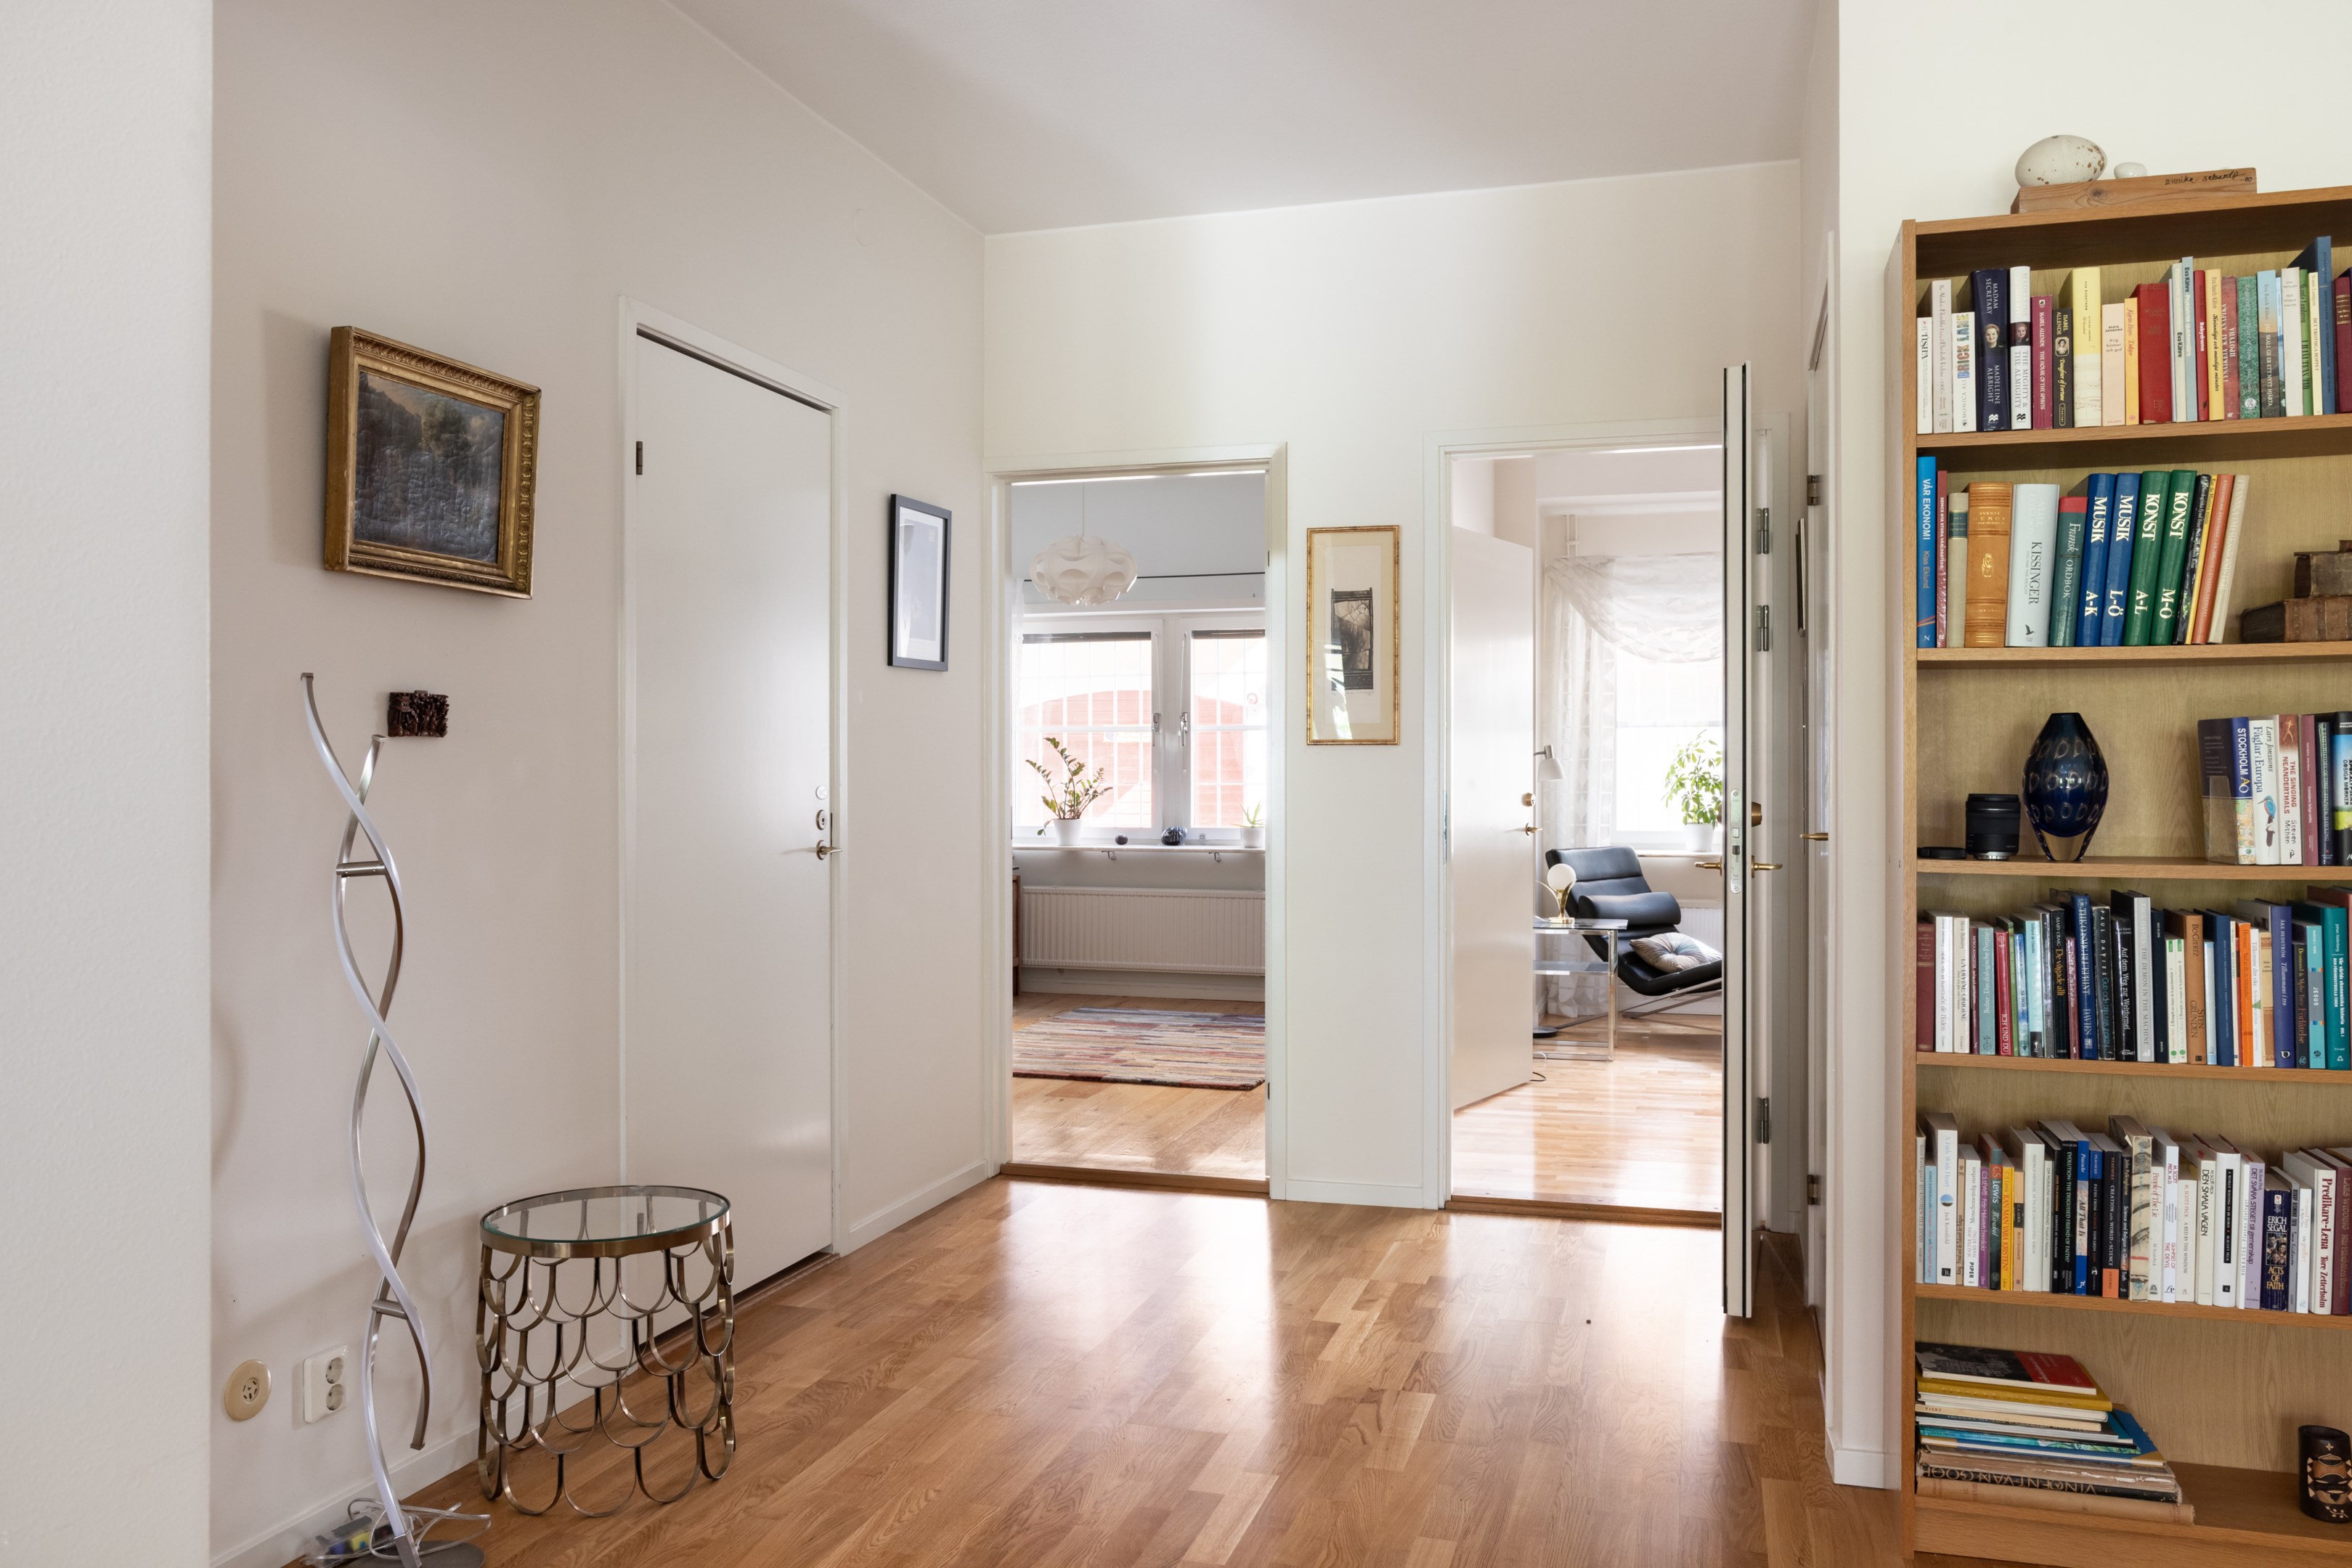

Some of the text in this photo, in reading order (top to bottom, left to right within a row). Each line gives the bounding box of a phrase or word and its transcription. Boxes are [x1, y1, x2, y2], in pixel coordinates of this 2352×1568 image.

[1956, 314, 1970, 379] BRICK LANE
[1922, 478, 1932, 495] VÅR
[2091, 496, 2108, 543] MUSIK
[2115, 494, 2134, 542] MUSIK
[2141, 494, 2161, 541] KONST
[2169, 491, 2189, 539] KONST
[2219, 479, 2246, 590] FRANSKA IMPRESSIONISTER
[2029, 541, 2043, 605] KISSINGER
[2062, 523, 2081, 598] Fransk ORDBOK
[2084, 590, 2099, 617] A-K
[2108, 589, 2124, 617] L-Ö
[2134, 589, 2149, 616] A-L
[2160, 587, 2176, 619] M-Ö
[2252, 726, 2264, 755] Fåglar
[2237, 727, 2250, 793] STOCKHOLM AÖ
[2266, 743, 2274, 772] Jonssons
[2254, 759, 2265, 793] Europa
[2080, 926, 2088, 951] COSMIC
[2056, 948, 2064, 959] De
[2055, 960, 2064, 984] vågade
[2081, 953, 2091, 995] BLUEPRINT
[2120, 973, 2130, 986] Weg
[2142, 989, 2149, 997] IN
[2083, 1009, 2092, 1034] DAVIES
[2123, 998, 2131, 1030] Weltformel
[2189, 1000, 2198, 1038] GRUNDEN
[2003, 1042, 2009, 1053] DU
[2151, 1172, 2160, 1191] People
[2152, 1196, 2162, 1208] The
[2152, 1208, 2160, 1217] Lie
[2321, 1178, 2333, 1249] Predikare-Lena
[2200, 1212, 2210, 1236] VÄGEN
[2267, 1215, 2287, 1225] ERICH
[2267, 1223, 2287, 1233] SEGAL
[2268, 1266, 2284, 1275] ACTS
[2266, 1281, 2284, 1290] FAITH
[2319, 1271, 2328, 1307] Zetterholm
[1924, 1466, 2097, 1494] VINCENT VAN GOGH
